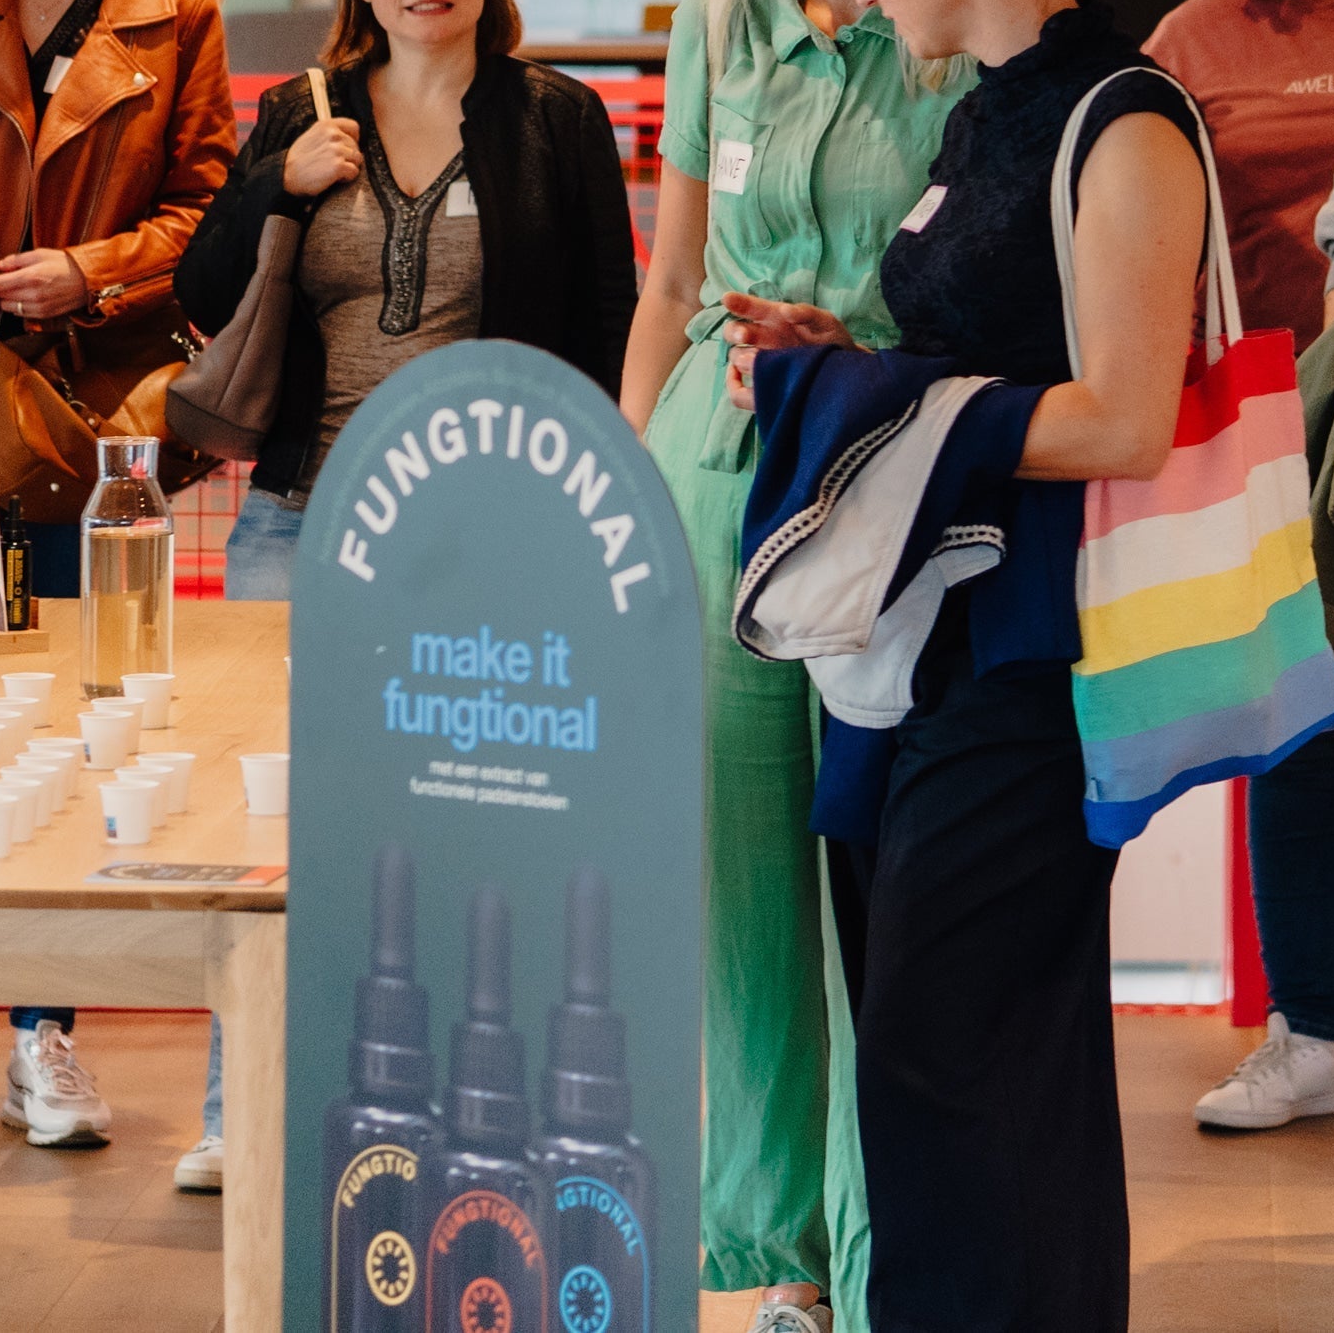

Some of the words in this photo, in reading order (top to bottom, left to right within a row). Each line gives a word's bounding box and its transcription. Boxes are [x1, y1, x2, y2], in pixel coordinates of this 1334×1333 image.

[338, 399, 651, 614] FUNGTIONAL
[412, 624, 534, 684] make
[542, 630, 572, 688] it
[382, 677, 599, 753] fungtional
